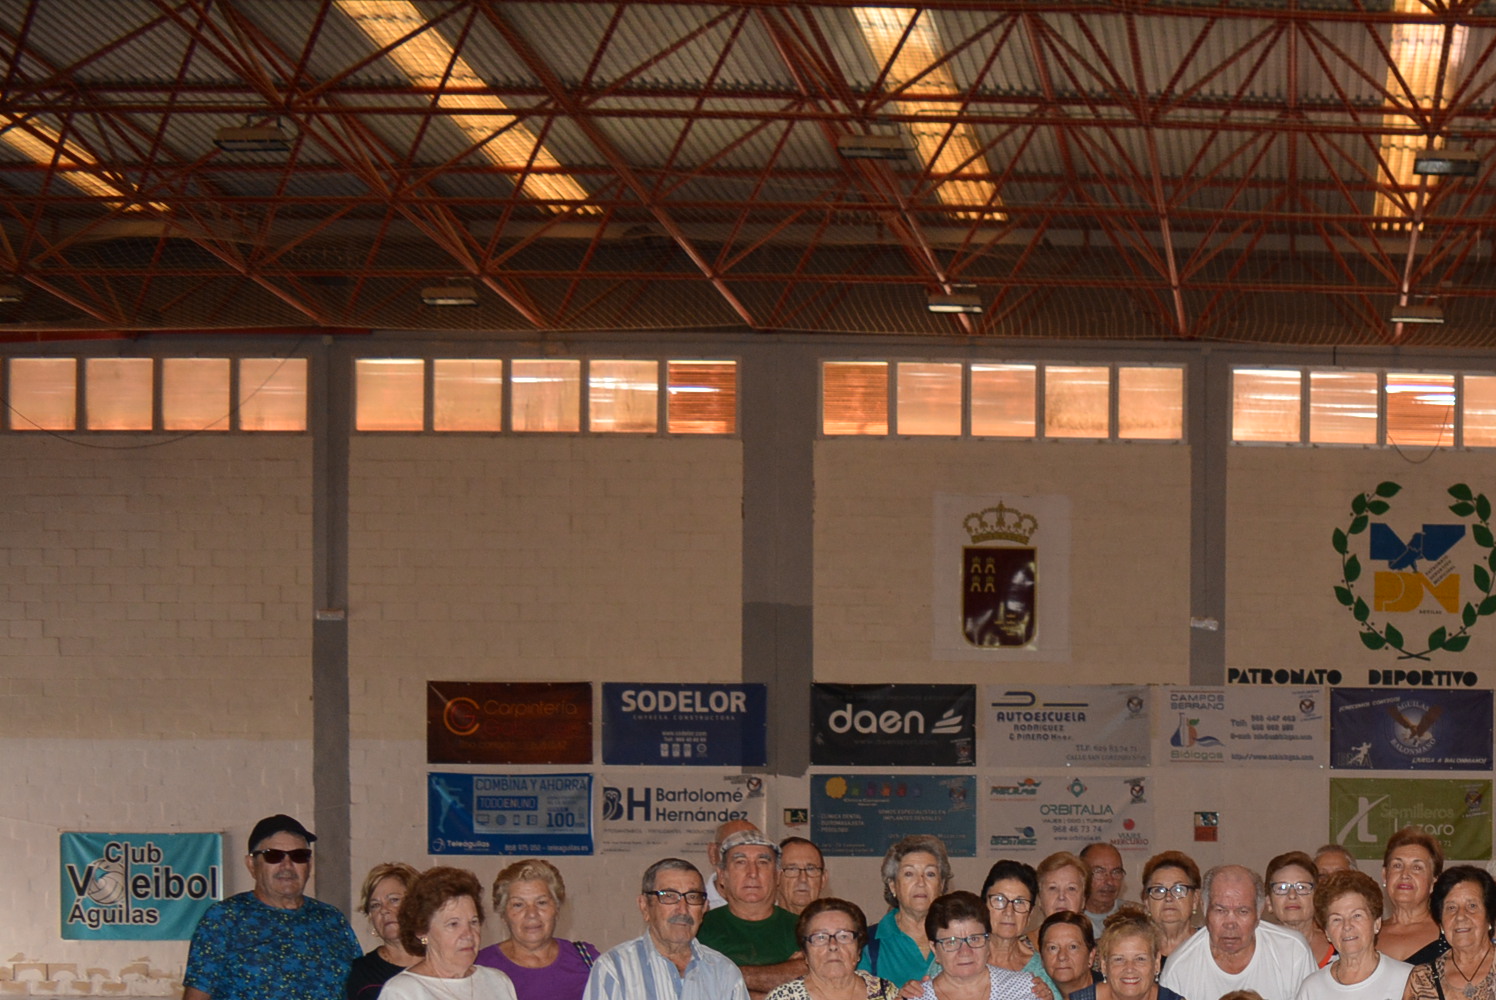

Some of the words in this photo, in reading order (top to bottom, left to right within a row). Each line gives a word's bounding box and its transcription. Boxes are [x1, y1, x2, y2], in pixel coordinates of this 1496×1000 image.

[1228, 668, 1342, 686] PATRONATO
[1368, 669, 1478, 687] DEPORTIVO
[621, 690, 748, 713] SODELOR
[1170, 693, 1225, 702] CAMPOS
[1170, 702, 1225, 711] SERRANO
[673, 714, 736, 722] CONSTRUCTORA
[828, 703, 925, 734] daen
[996, 711, 1087, 723] AUTOESCUELA
[1170, 749, 1224, 761] Biólogos
[475, 778, 527, 791] COMBINA
[530, 778, 537, 791] Y
[539, 778, 587, 791] AHORRA
[656, 787, 744, 803] Bartolomé
[656, 806, 748, 822] Hernández
[1040, 804, 1114, 815] ORBITALIA
[1380, 802, 1455, 819] Semilleros
[546, 812, 575, 828] 100
[1110, 838, 1149, 846] MERCURIO
[105, 842, 162, 864] Club
[68, 898, 160, 928] Águilas
